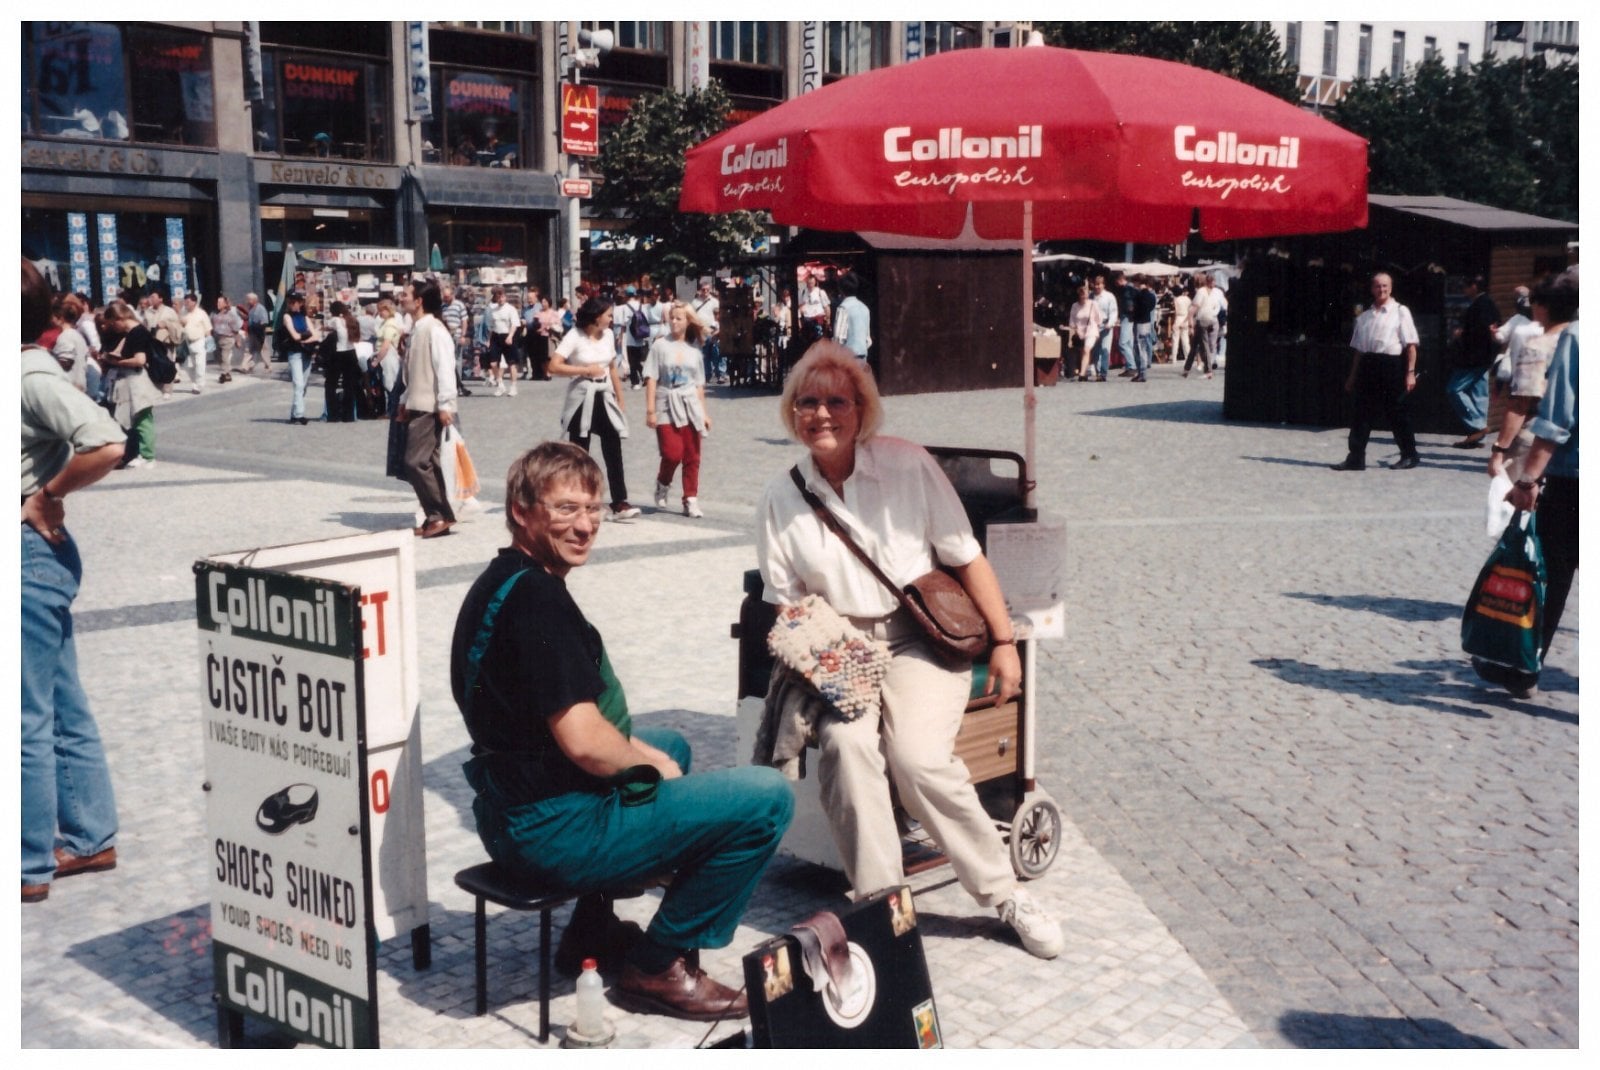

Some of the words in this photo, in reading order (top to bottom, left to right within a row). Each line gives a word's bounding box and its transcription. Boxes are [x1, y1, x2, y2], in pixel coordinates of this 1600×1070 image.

[284, 63, 359, 86] DUNKIN'
[449, 80, 512, 100] DUNKIN'
[109, 150, 124, 172] &
[883, 125, 1043, 163] Collonil
[1173, 125, 1300, 169] Collonil
[346, 167, 357, 186] &
[362, 168, 388, 188] Co.
[895, 165, 1033, 195] europolish
[1181, 170, 1291, 200] europolish
[208, 571, 337, 647] Collonil
[297, 672, 346, 742] BOT
[214, 718, 240, 746] VAŠE
[241, 729, 266, 756] BOTY
[269, 731, 289, 761] NÁS
[293, 741, 351, 779] POTŘEBUJÍ
[215, 837, 274, 899] SHOES
[286, 861, 356, 929] SHINED
[220, 902, 250, 930] YOUR
[256, 914, 294, 948] SHOES
[300, 930, 330, 962] NEED
[335, 944, 352, 970] US
[226, 952, 354, 1049] Collonil
